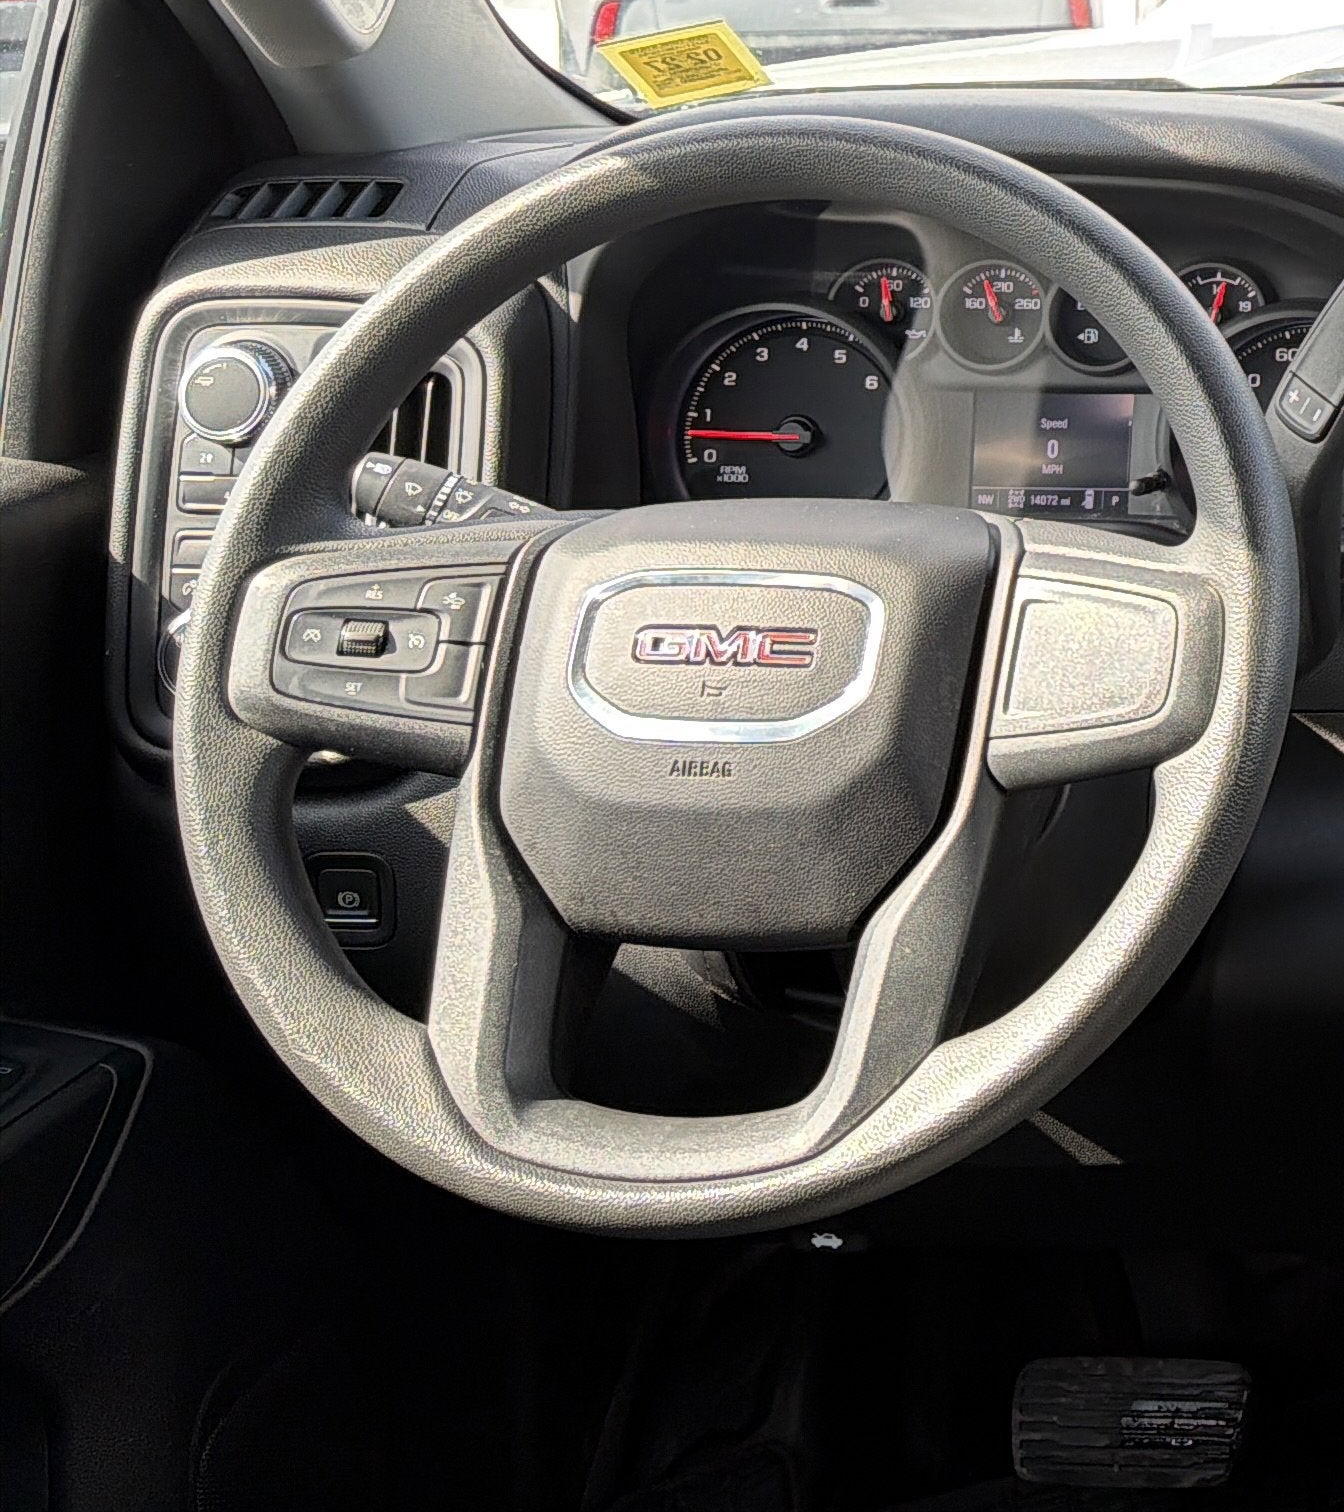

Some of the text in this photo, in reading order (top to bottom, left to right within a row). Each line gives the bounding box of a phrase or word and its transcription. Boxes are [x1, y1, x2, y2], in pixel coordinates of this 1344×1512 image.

[993, 281, 1014, 293] 210
[859, 296, 870, 308] 0
[909, 297, 931, 308] 120
[965, 297, 986, 309] 160
[1014, 298, 1041, 310] 260
[1239, 301, 1252, 312] 19
[795, 338, 809, 351] 4
[756, 348, 769, 362] 3
[833, 350, 848, 364] 5
[1275, 347, 1300, 362] 60
[723, 372, 737, 387] 2
[865, 376, 879, 390] 6
[704, 409, 712, 422] 1
[1041, 417, 1068, 432] Speed
[703, 448, 717, 463] 0
[1047, 440, 1059, 459] 0
[719, 465, 747, 475] RPM
[1042, 464, 1063, 474] MPH
[978, 494, 994, 505] NW
[1030, 495, 1059, 506] 14072
[1060, 496, 1071, 506] mi
[1111, 496, 1120, 506] P
[365, 590, 384, 600] RES
[631, 625, 818, 668] GMC
[344, 682, 363, 692] SET
[668, 758, 734, 779] AIRBAG
